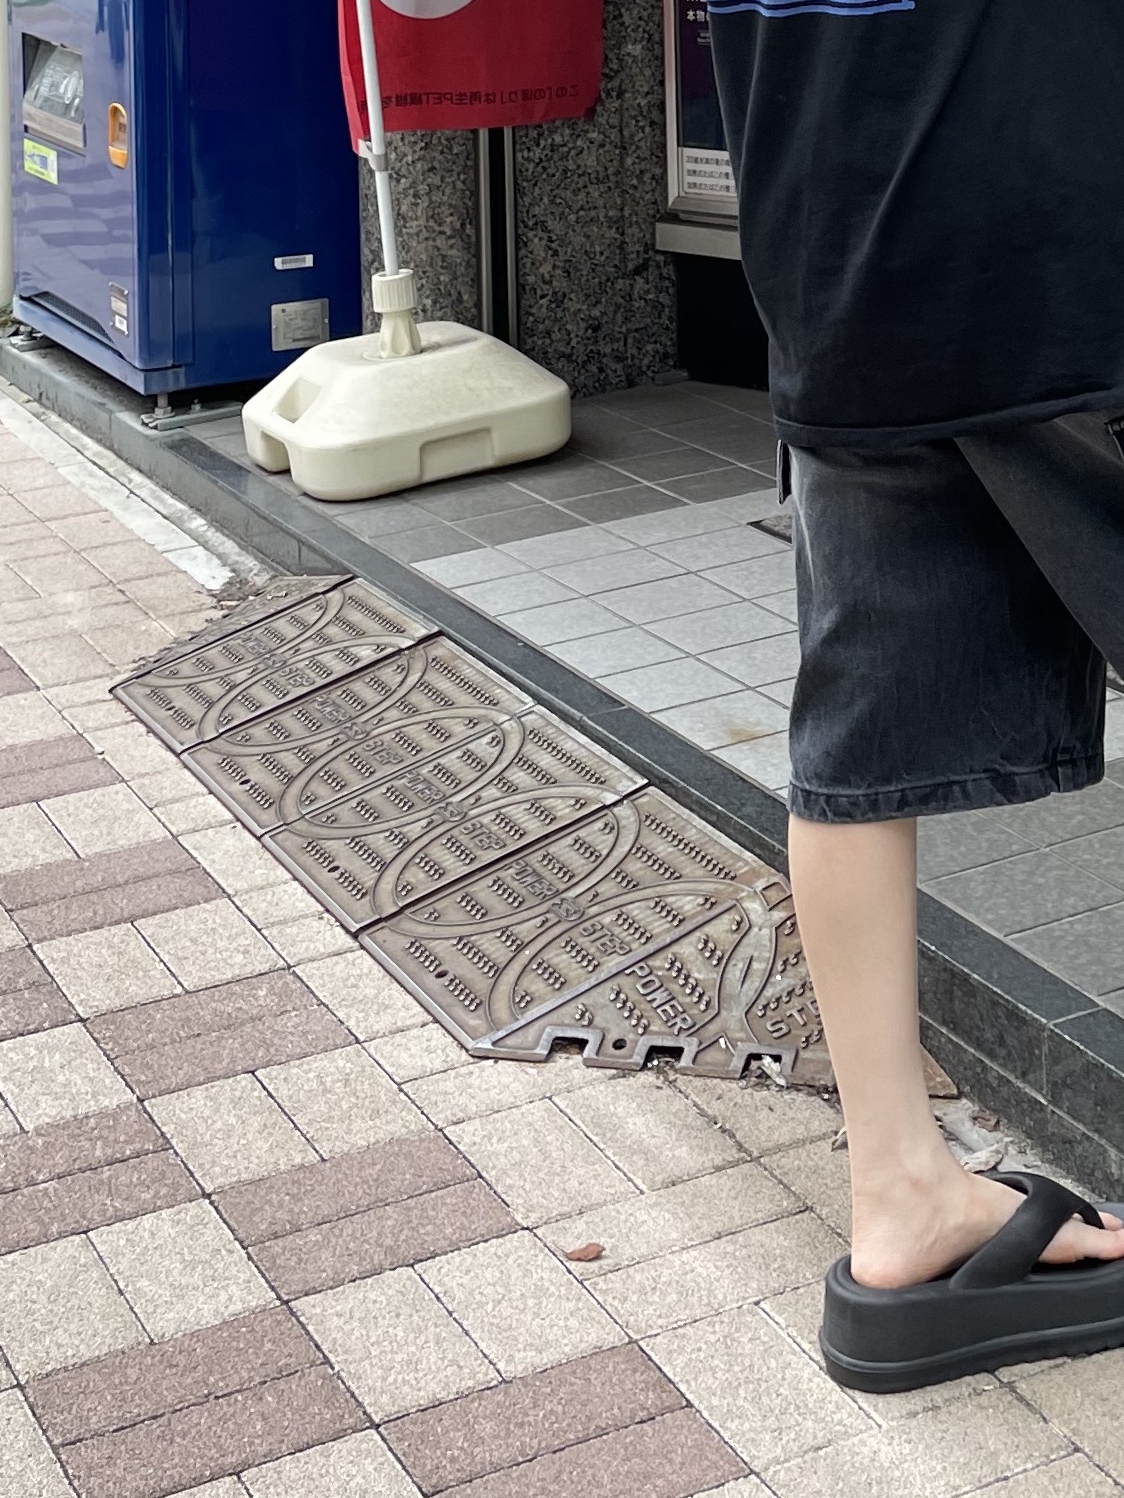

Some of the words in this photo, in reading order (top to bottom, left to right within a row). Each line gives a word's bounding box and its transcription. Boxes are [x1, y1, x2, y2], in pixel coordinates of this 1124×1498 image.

[399, 769, 447, 804] POWER
[460, 820, 507, 851] STEP
[504, 858, 560, 900] POWER
[580, 920, 632, 956] STEP
[624, 961, 697, 1036] POWER
